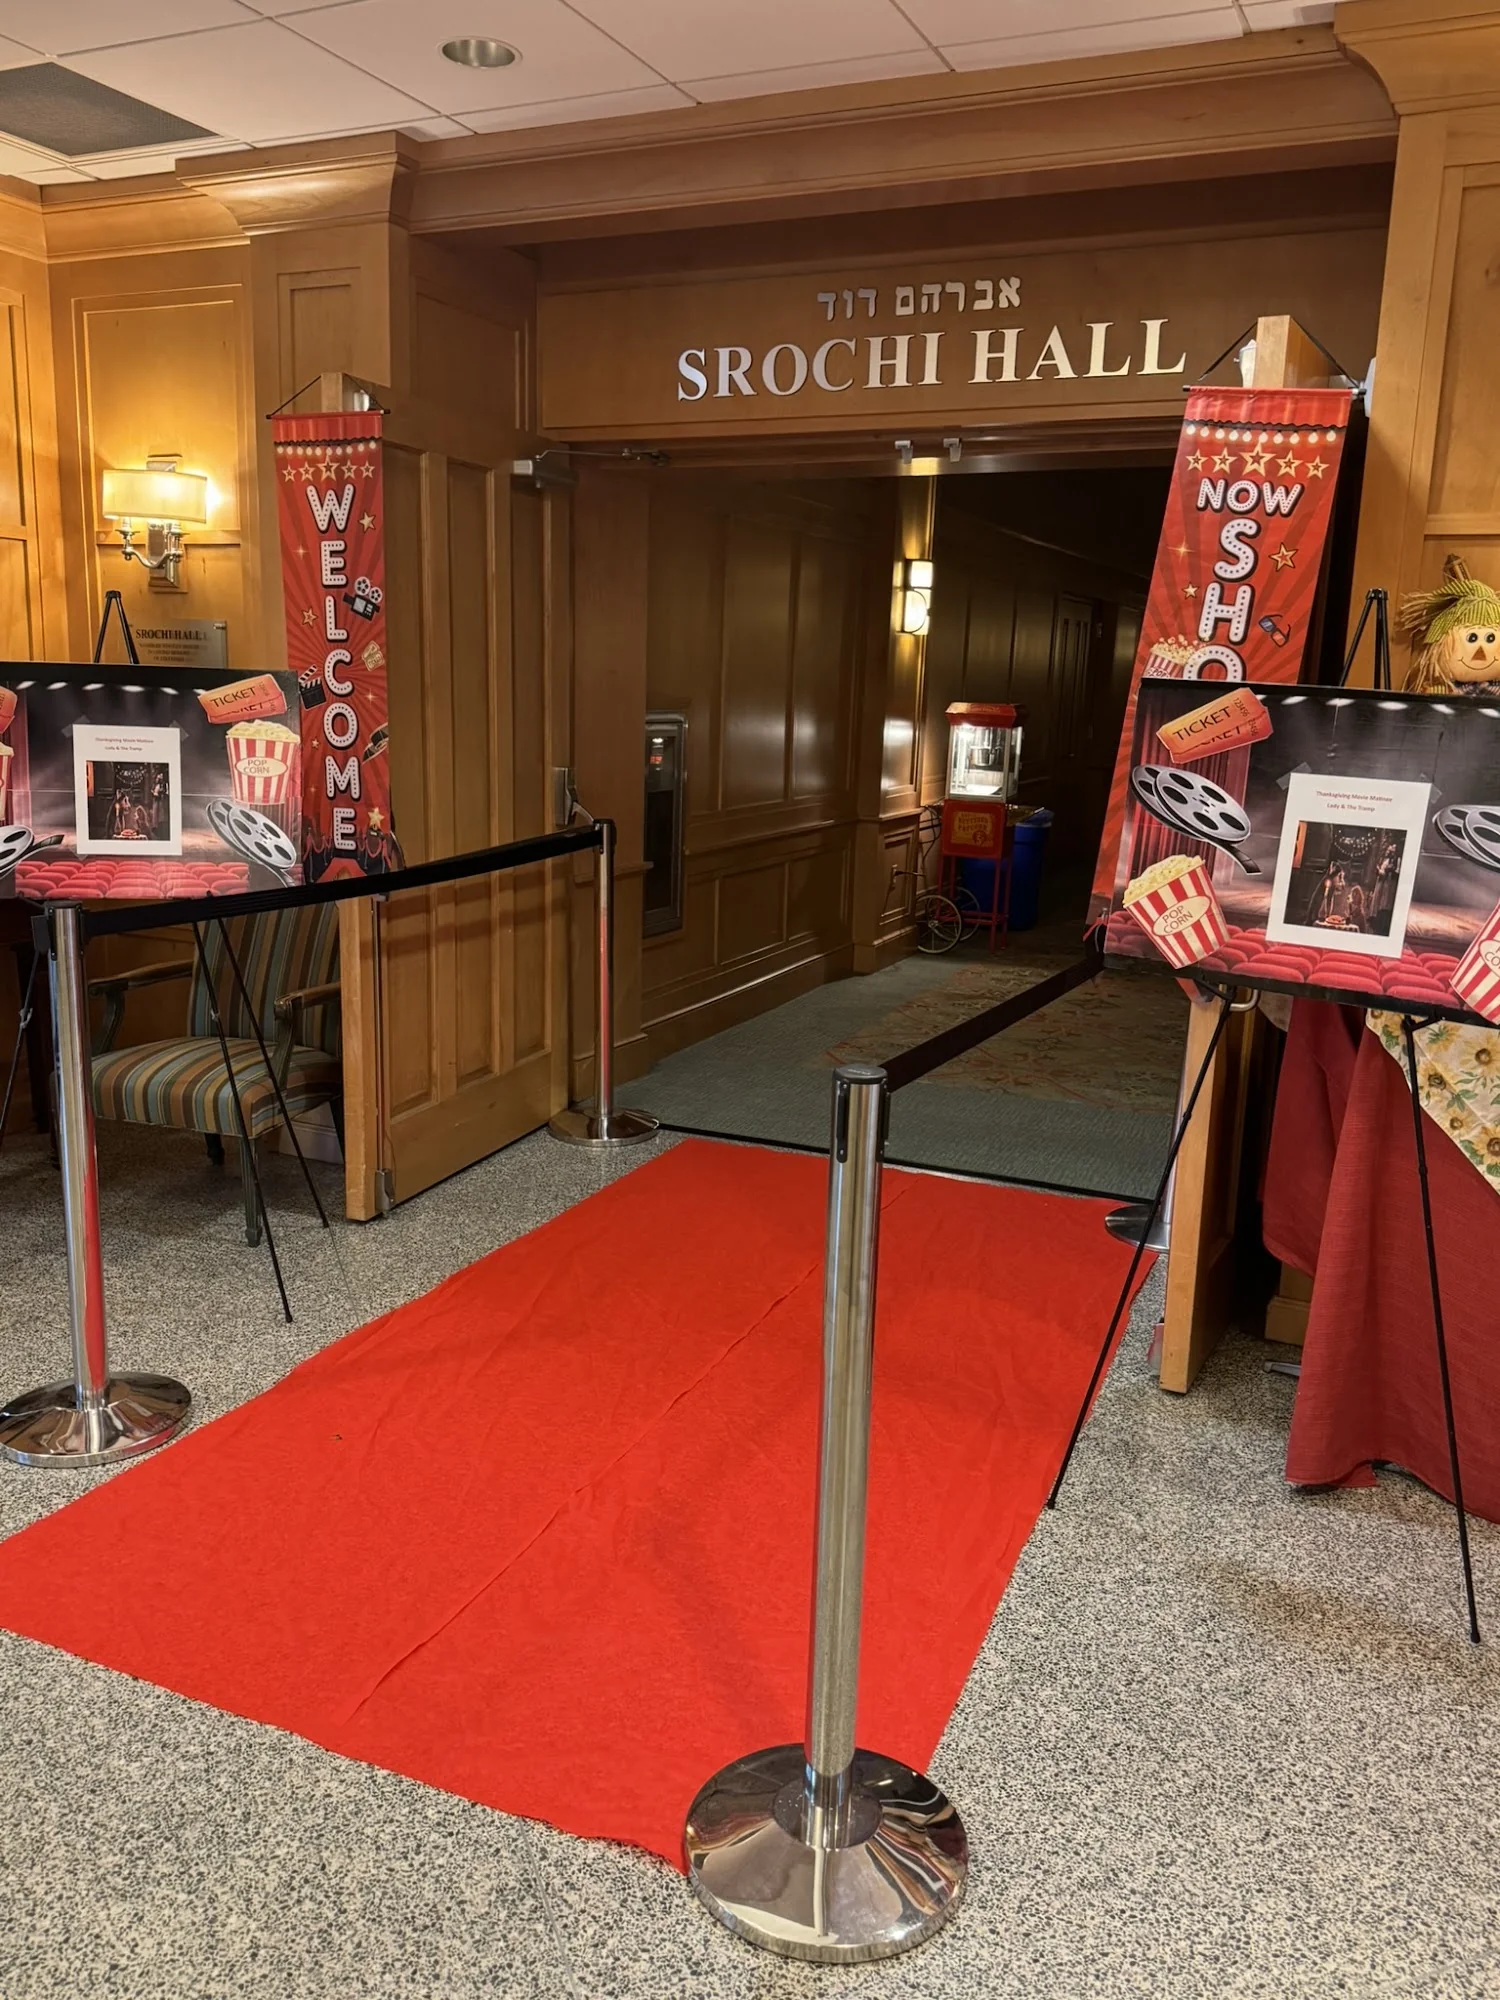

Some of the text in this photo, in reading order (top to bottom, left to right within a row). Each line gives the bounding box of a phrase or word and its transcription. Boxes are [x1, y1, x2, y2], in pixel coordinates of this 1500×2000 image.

[816, 276, 1021, 321] אברהם דוד
[677, 318, 1187, 401] SROCHI HALL
[1197, 477, 1303, 515] NOW
[1183, 518, 1258, 681] SHO
[136, 629, 202, 641] SROCHI HALL
[306, 483, 360, 850] WELCOME
[210, 686, 256, 708] TICKET
[1173, 706, 1232, 740] TICKET
[243, 766, 270, 774] CORN
[247, 759, 268, 767] POP
[1316, 791, 1351, 800] Thanksgiving
[1162, 905, 1184, 923] POP
[1163, 911, 1193, 934] CORN
